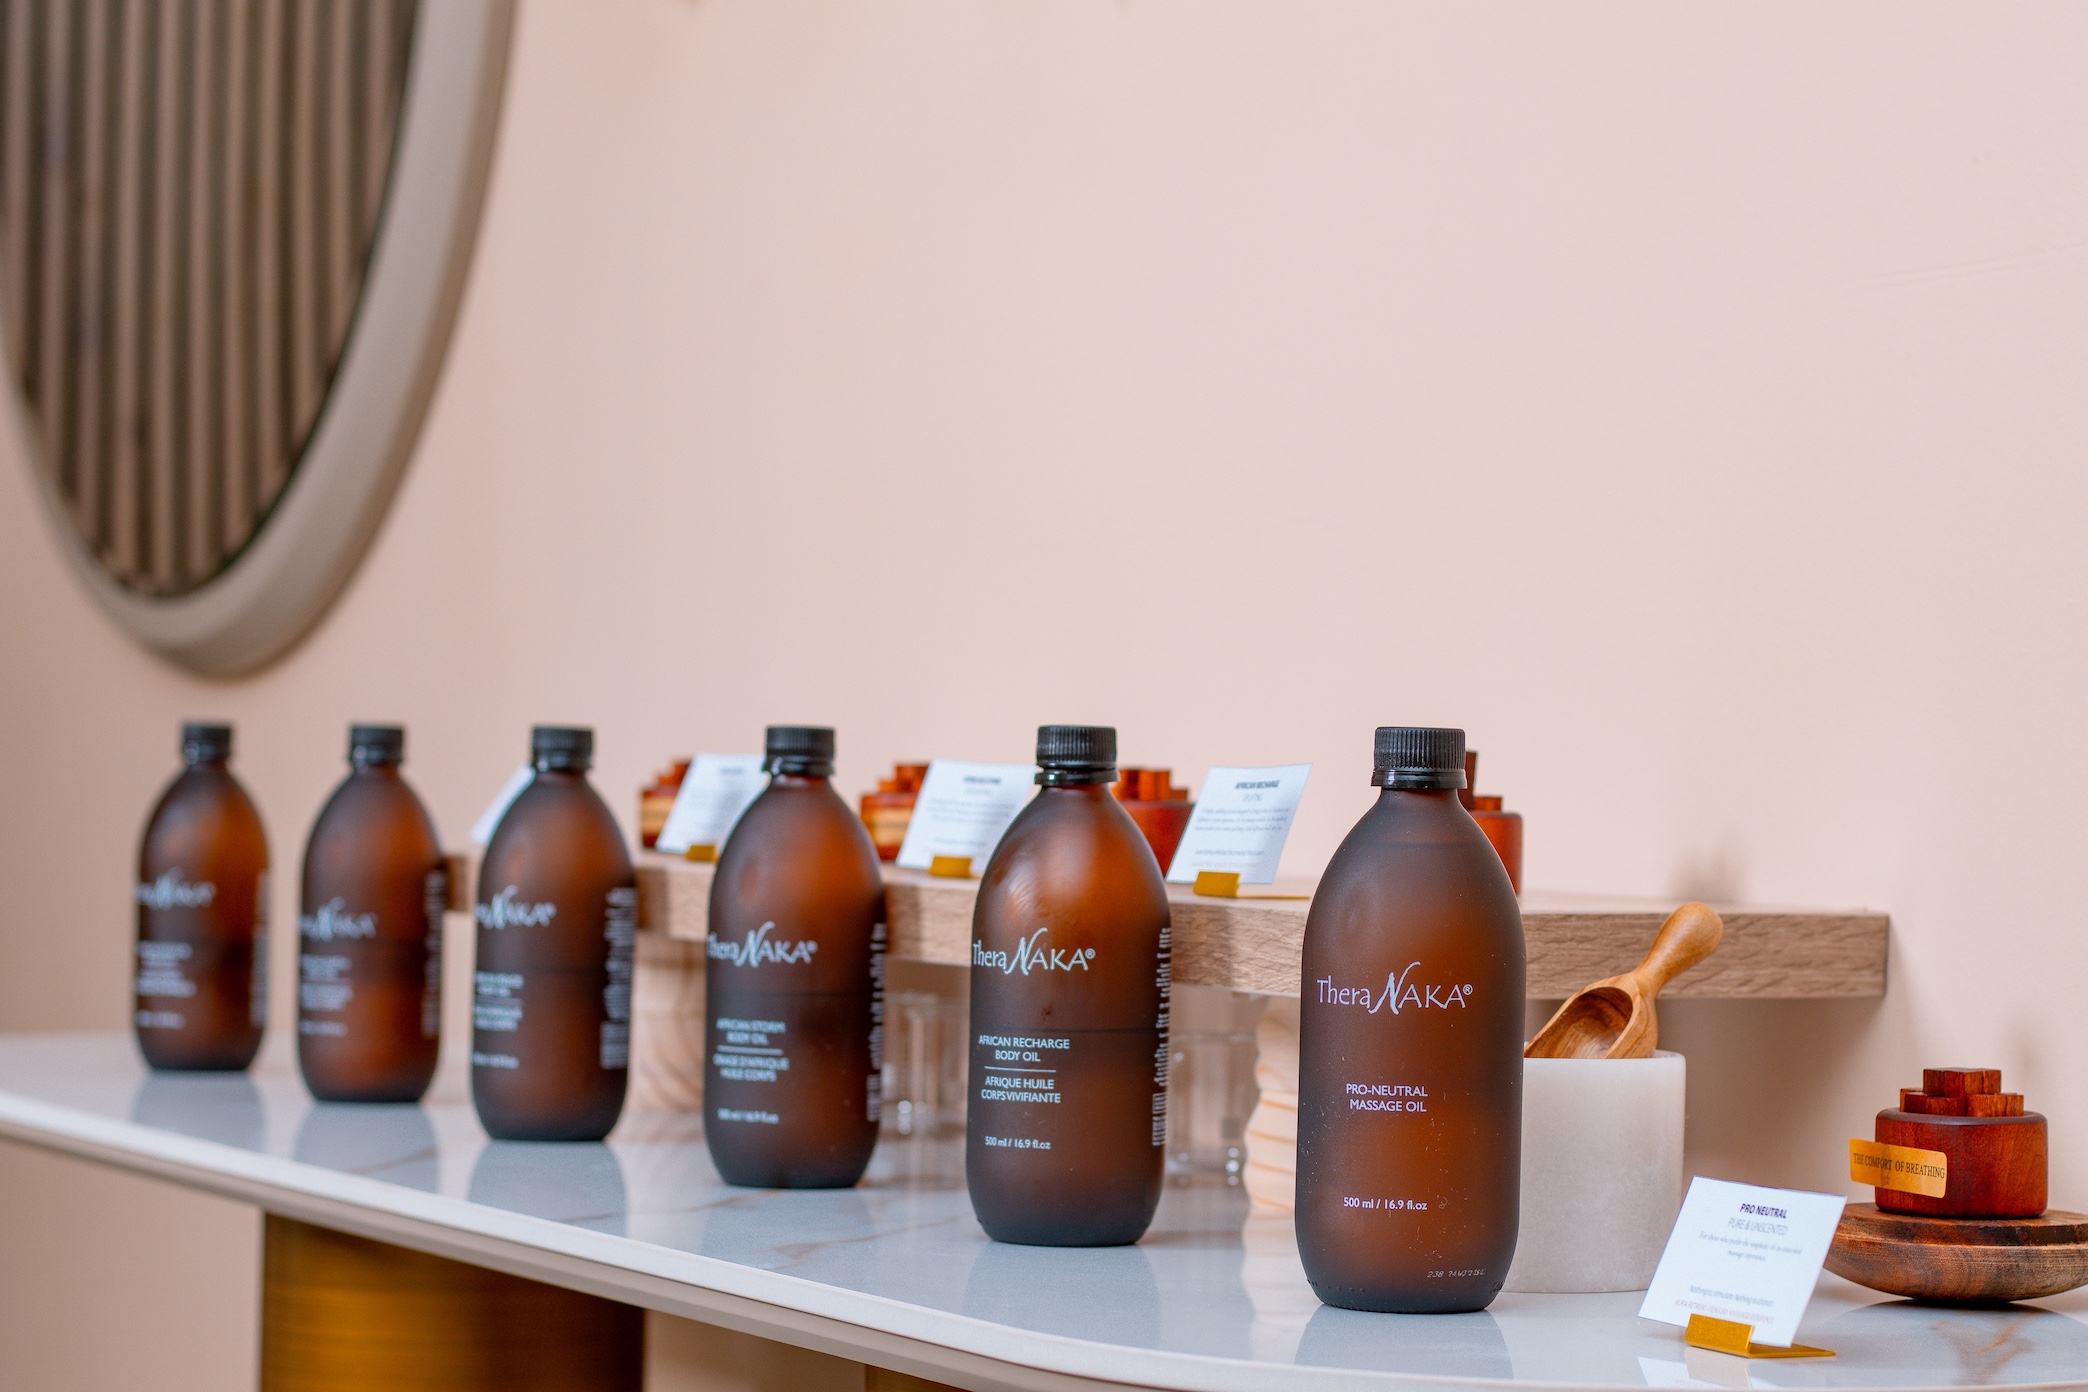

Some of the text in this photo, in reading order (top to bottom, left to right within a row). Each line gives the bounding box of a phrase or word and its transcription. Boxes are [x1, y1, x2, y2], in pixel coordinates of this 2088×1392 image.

[979, 1034, 1070, 1049] AFRICAN RECHARGE
[995, 1050, 1041, 1062] BODY OIL
[985, 1076, 1055, 1090] AFRIQUE HUILE
[1345, 1083, 1429, 1097] PRO-NEUTRAL
[1349, 1099, 1427, 1113] MASSAGE OIL
[984, 1136, 997, 1146] 500
[997, 1138, 1007, 1147] ml
[1014, 1139, 1031, 1149] 16.9
[1853, 1152, 1946, 1179] THE COMFORT OF BREATHING
[1343, 1196, 1360, 1208] 500
[1361, 1198, 1374, 1209] ml
[1384, 1199, 1405, 1210] 16.9
[1406, 1199, 1428, 1211] fl.oz
[1739, 1203, 1787, 1219] PRO NEUTRAL
